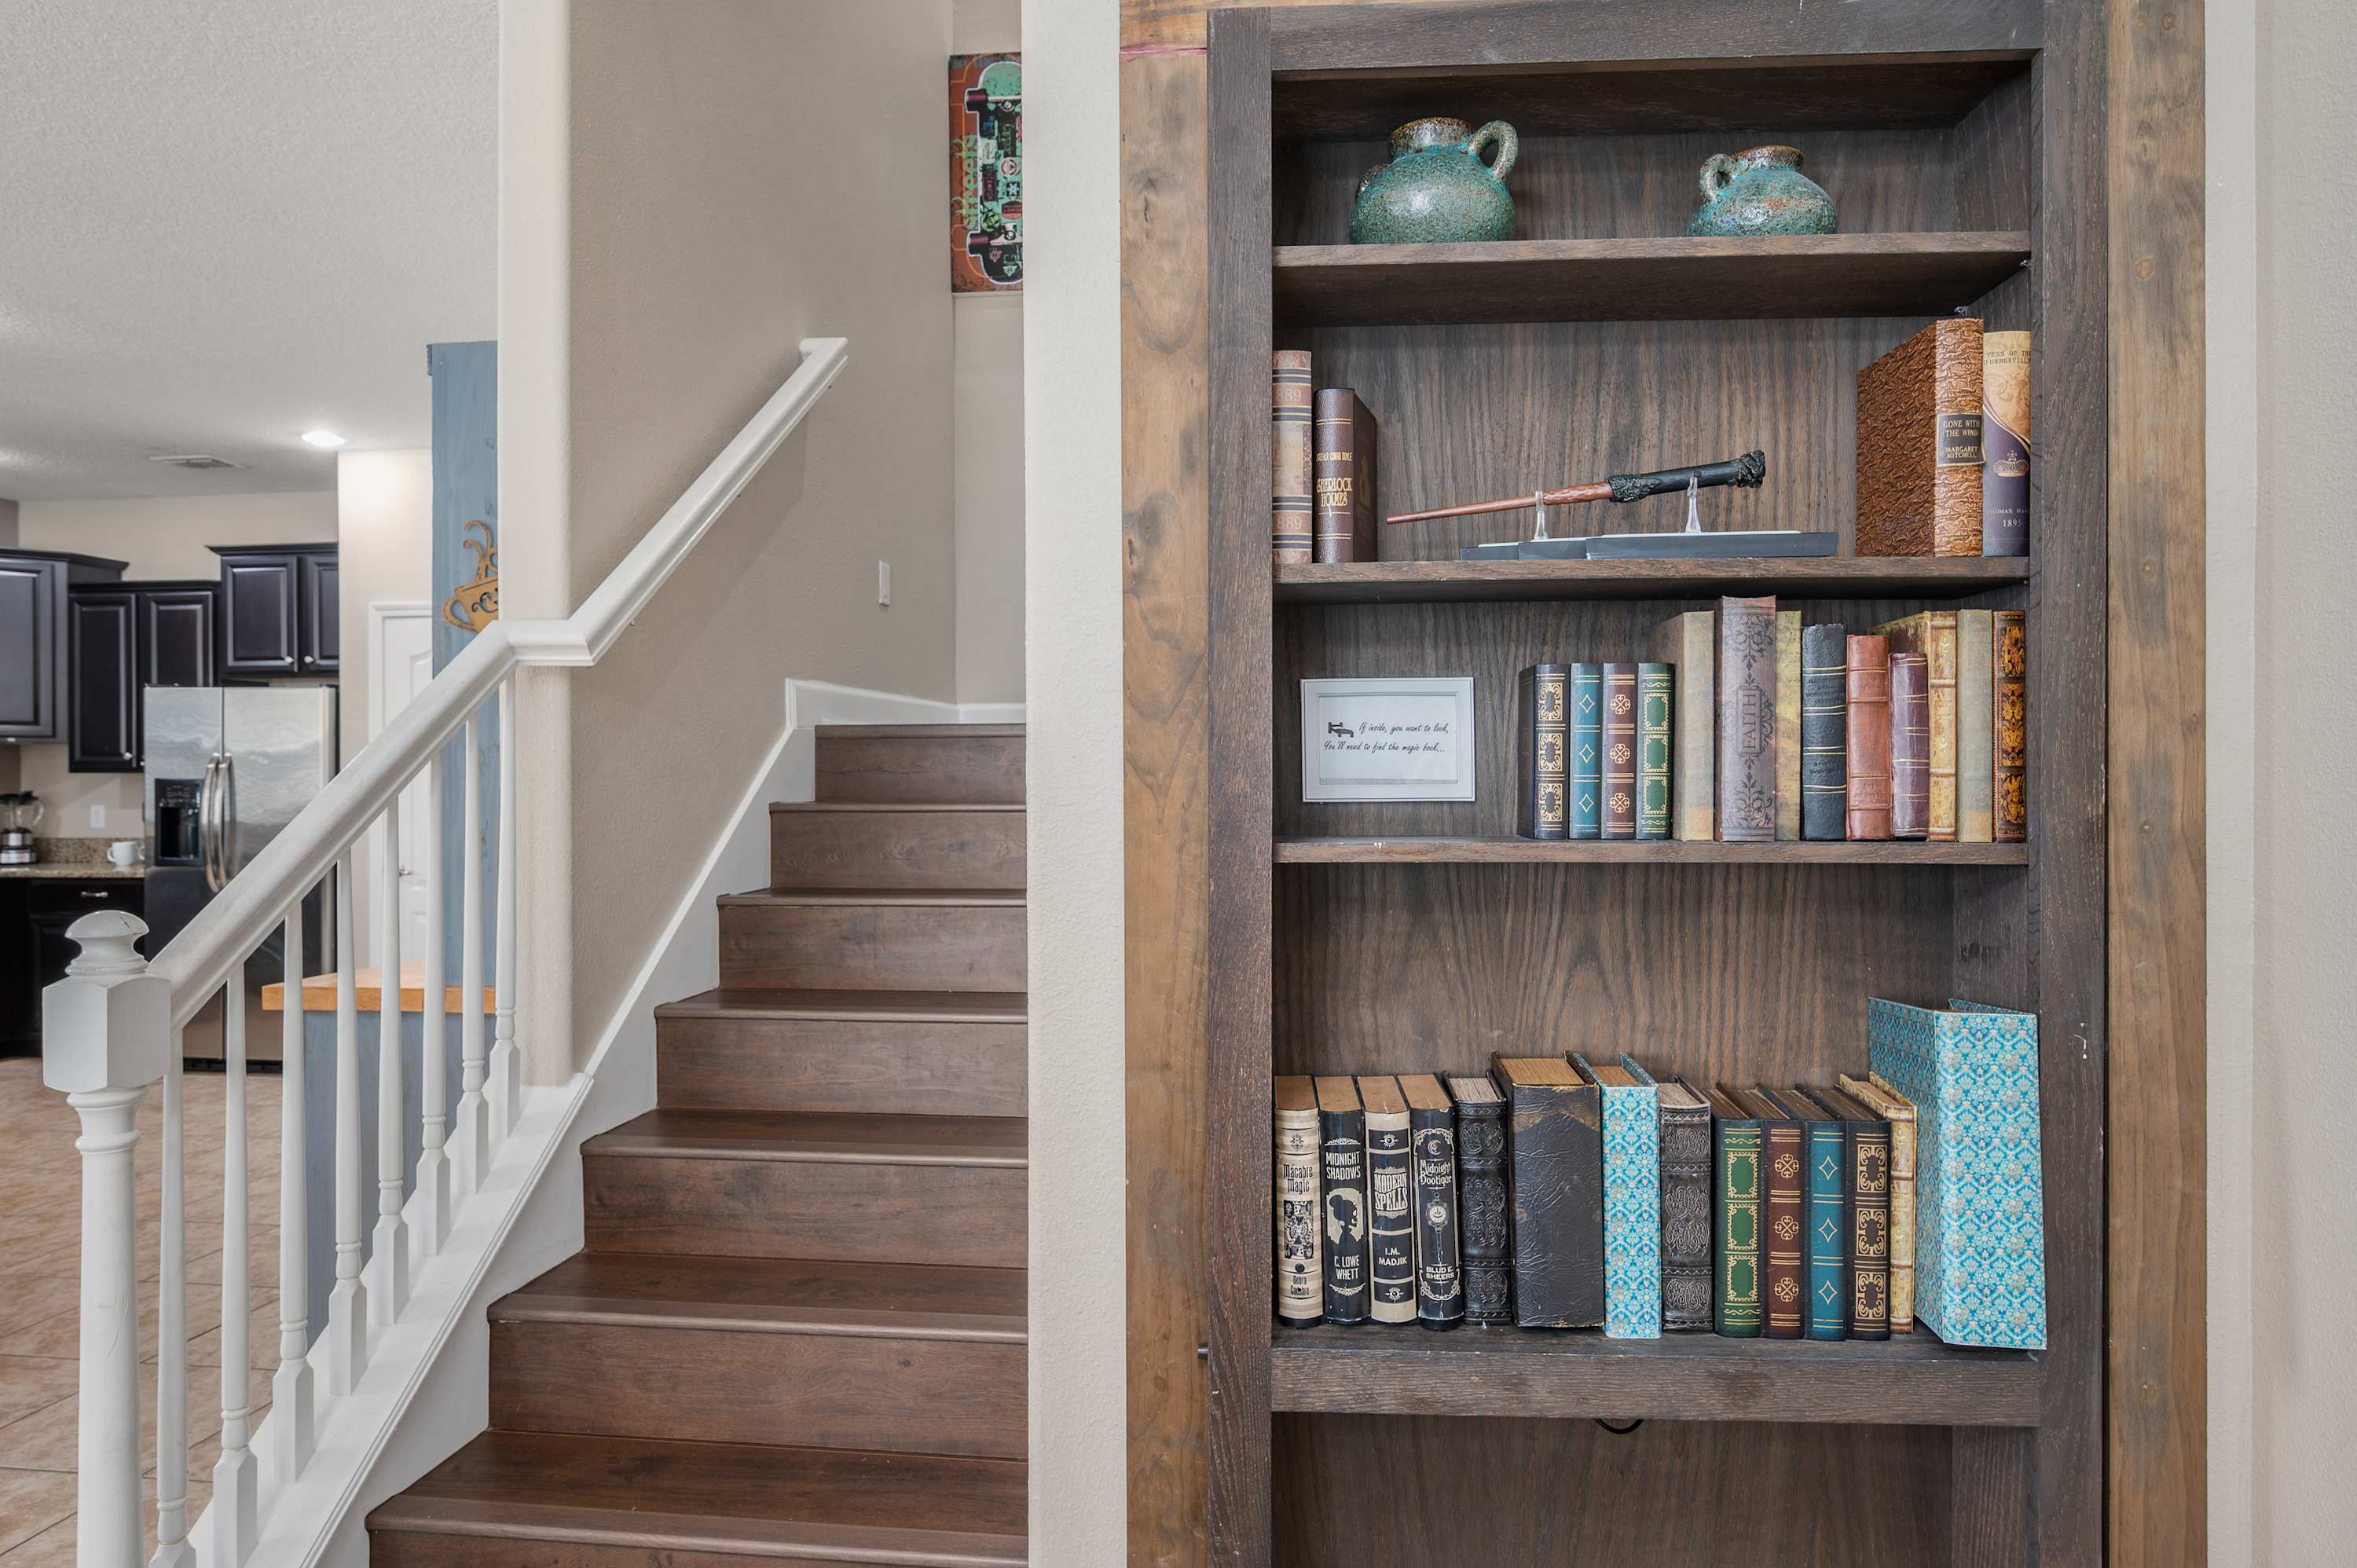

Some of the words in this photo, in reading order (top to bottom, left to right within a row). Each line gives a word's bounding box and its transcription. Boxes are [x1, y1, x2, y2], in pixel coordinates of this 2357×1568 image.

[1965, 419, 1980, 428] WITH
[1316, 477, 1352, 493] SHERLOCK
[1321, 492, 1347, 507] HOLMES
[1358, 722, 1366, 735] If
[1368, 722, 1387, 733] inside,
[1389, 724, 1403, 735] you
[1405, 724, 1422, 733] want
[1433, 723, 1449, 735] look,
[1742, 694, 1756, 750] FAITH
[1324, 740, 1346, 750] You'll
[1346, 741, 1362, 750] need
[1372, 741, 1387, 753] find
[1388, 742, 1398, 750] the
[1402, 745, 1420, 754] magic
[1326, 1151, 1360, 1166] MIDNIGHT
[1283, 1163, 1313, 1178] Macabre
[1326, 1166, 1361, 1180] SHADOWS
[1419, 1160, 1451, 1177] Midnight
[1288, 1178, 1310, 1195] Magic
[1374, 1173, 1407, 1193] MODERN
[1419, 1171, 1452, 1187] Bootique
[1374, 1187, 1408, 1211] SPELLS
[1334, 1255, 1340, 1267] C.
[1342, 1255, 1359, 1267] LOWE
[1379, 1257, 1407, 1266] MADJIK
[1336, 1268, 1359, 1280] WHETT
